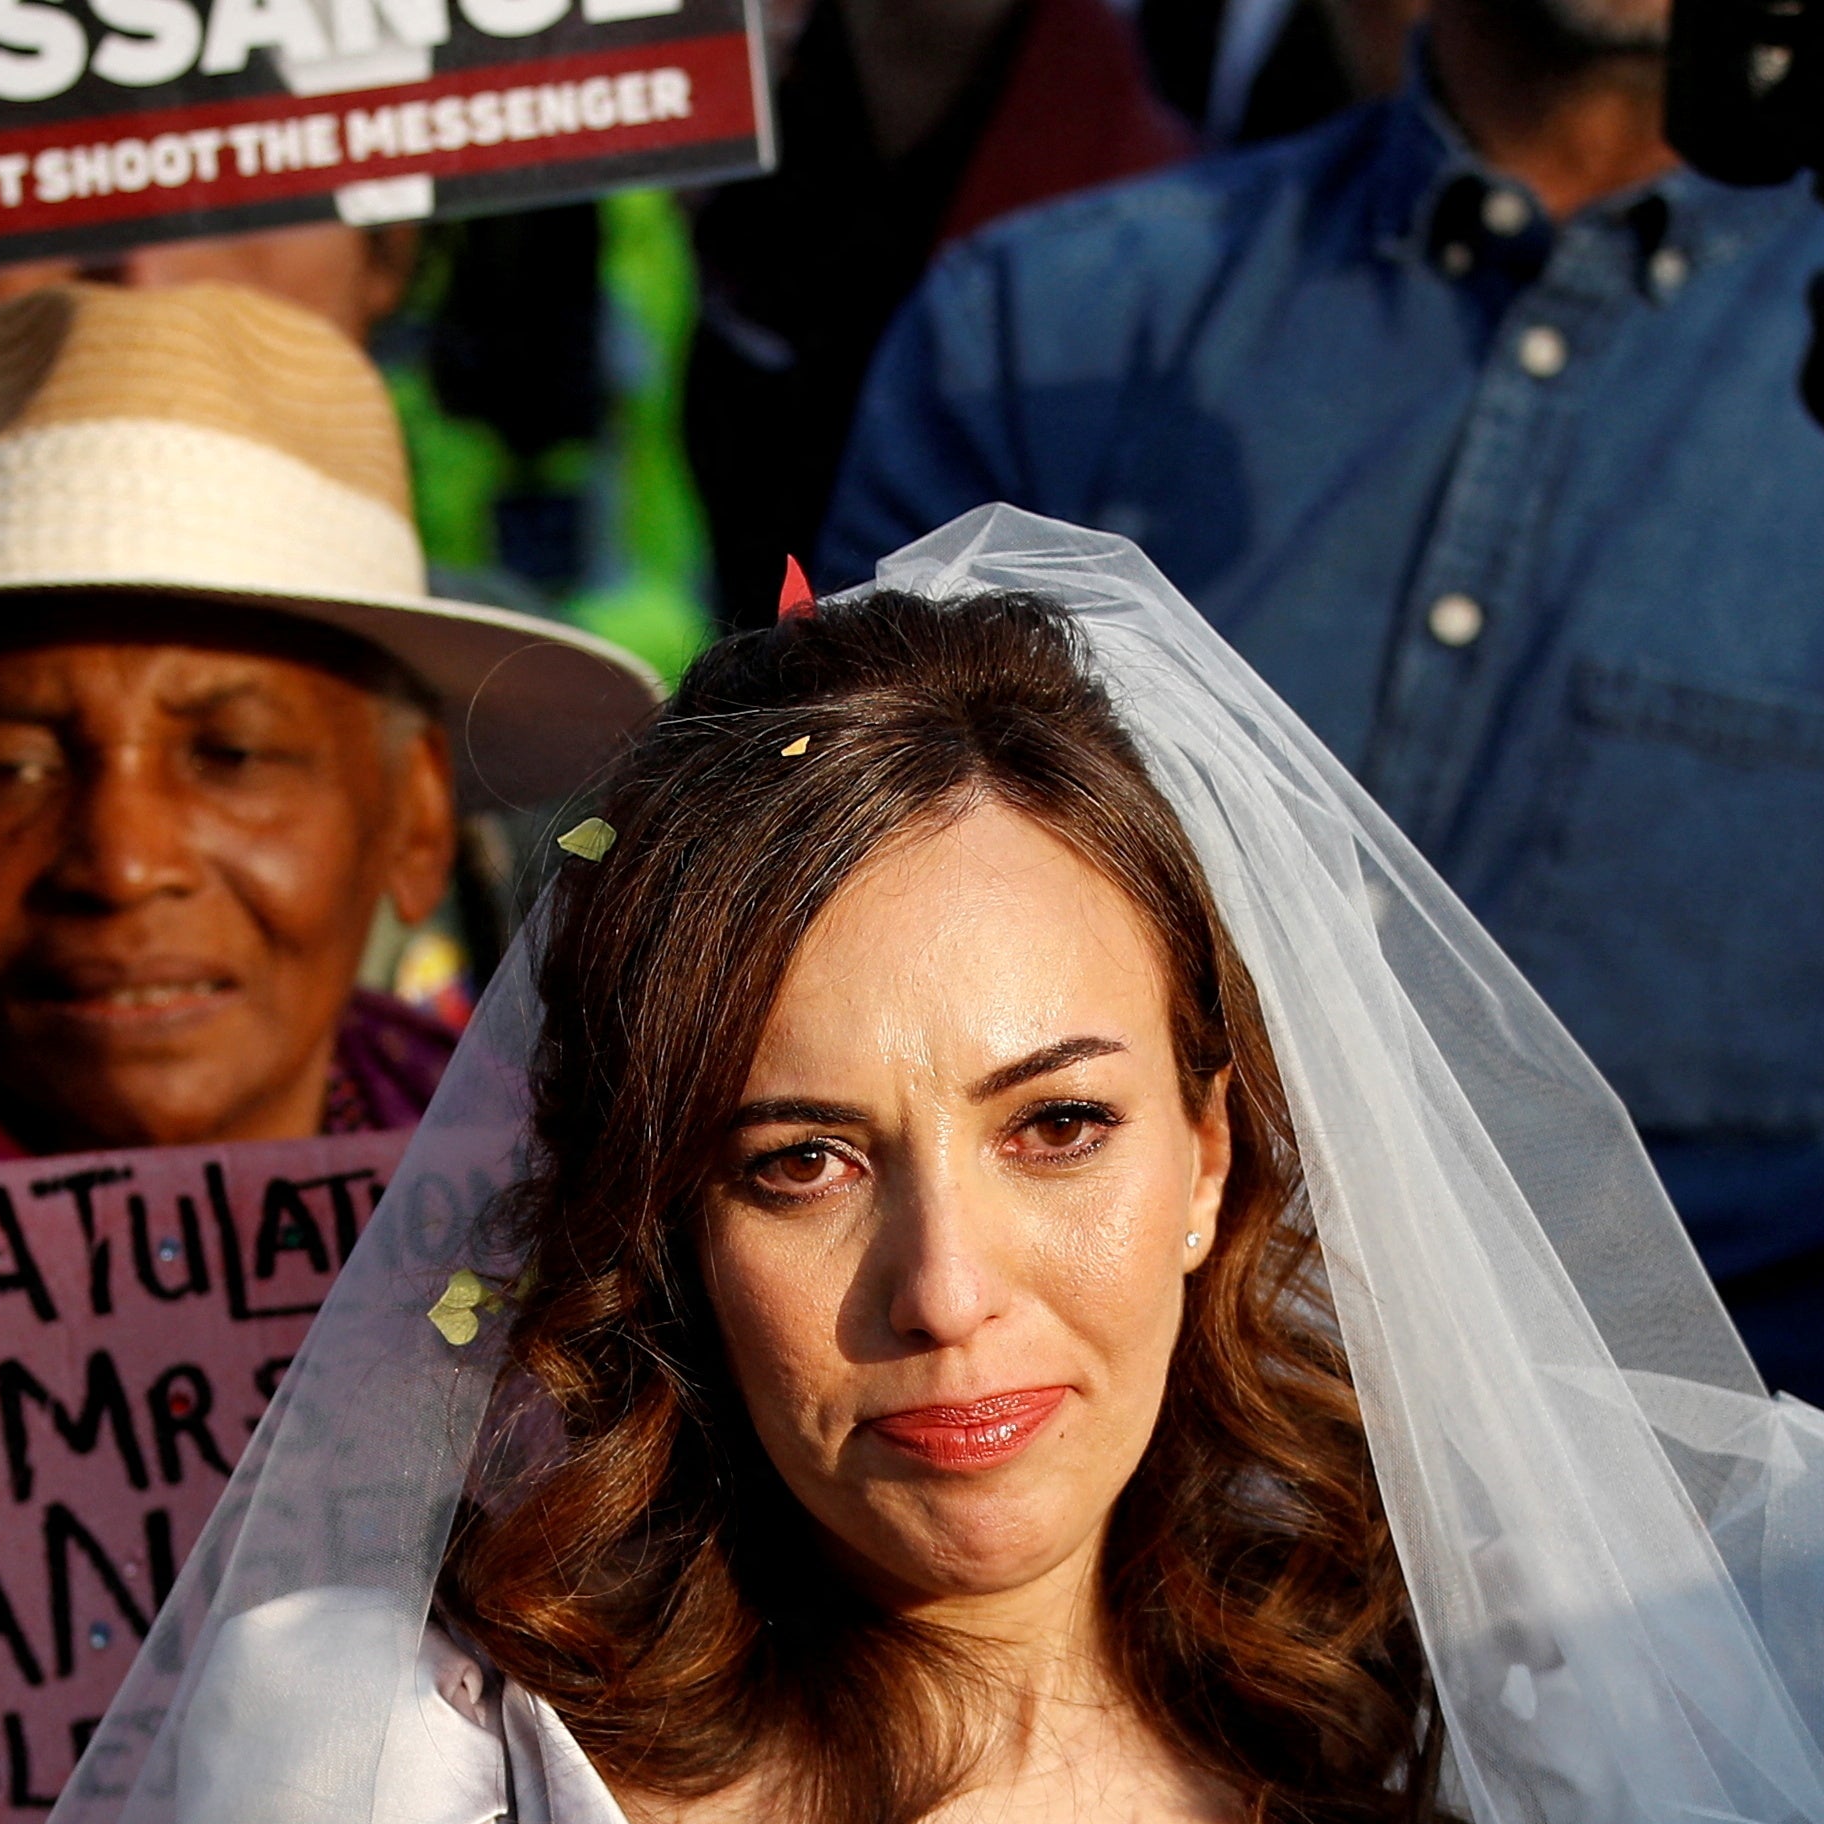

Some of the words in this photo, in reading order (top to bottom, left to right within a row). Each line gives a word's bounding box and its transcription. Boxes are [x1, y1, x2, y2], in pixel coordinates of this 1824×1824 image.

[34, 128, 222, 203] SHOOT
[227, 111, 342, 178] THE
[347, 67, 693, 162] MESSENGER
